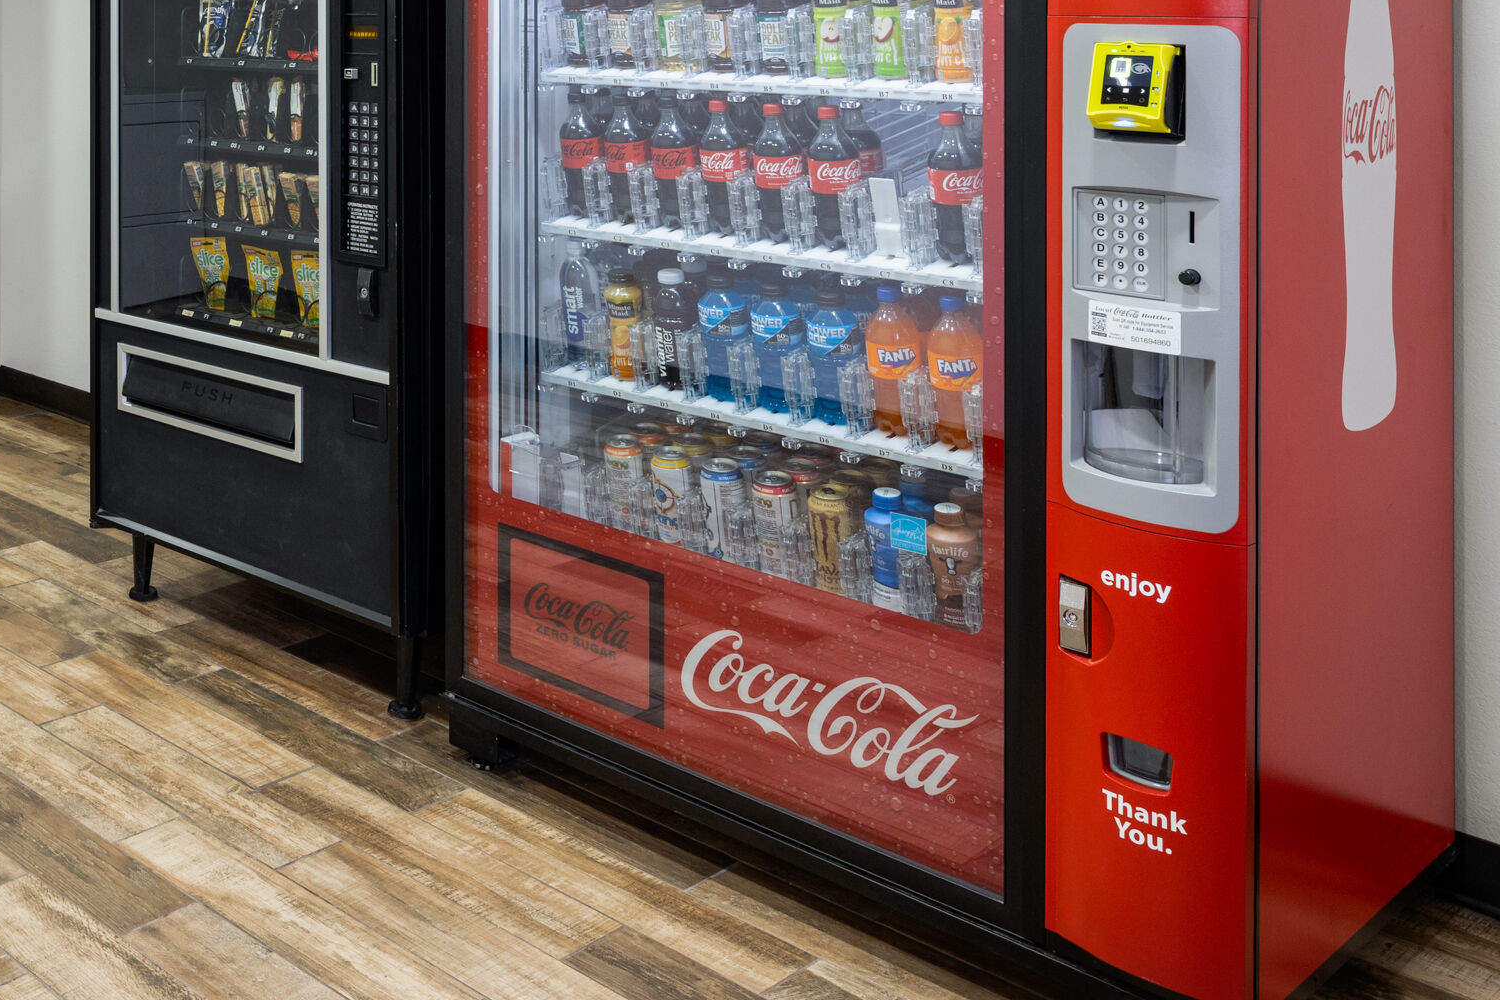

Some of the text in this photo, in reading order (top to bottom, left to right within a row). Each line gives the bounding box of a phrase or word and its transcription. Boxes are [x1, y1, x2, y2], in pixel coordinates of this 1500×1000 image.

[1097, 198, 1104, 206] A
[1118, 200, 1123, 208] 1
[1138, 201, 1145, 210] 2
[1097, 213, 1104, 221] B
[1117, 215, 1124, 223] 3
[1138, 217, 1145, 225] 4
[1097, 228, 1105, 237] C
[1118, 230, 1124, 239] 5
[1138, 232, 1144, 241] 6
[1097, 244, 1105, 252] D
[1118, 245, 1124, 254] 7
[1138, 248, 1144, 256] 8
[196, 248, 225, 267] slice
[1097, 259, 1104, 267] E
[250, 256, 279, 277] slice
[1118, 261, 1124, 270] 9
[1097, 274, 1104, 282] F
[574, 286, 584, 309] water
[563, 286, 579, 335] smart
[807, 323, 846, 337] POWER
[655, 326, 667, 377] vitamin
[663, 328, 675, 363] water
[877, 347, 916, 363] FANTA
[936, 358, 977, 374] FANTA
[181, 380, 233, 405] PUSH
[941, 463, 953, 471] D8
[931, 543, 969, 558] fairlife
[1100, 569, 1172, 604] enjoy
[524, 582, 637, 650] Coca-Cola
[536, 622, 617, 660] ZERO SUGAR
[680, 629, 979, 797] Coca-Cola
[1102, 787, 1188, 836] Thank
[1113, 816, 1173, 856] You.
